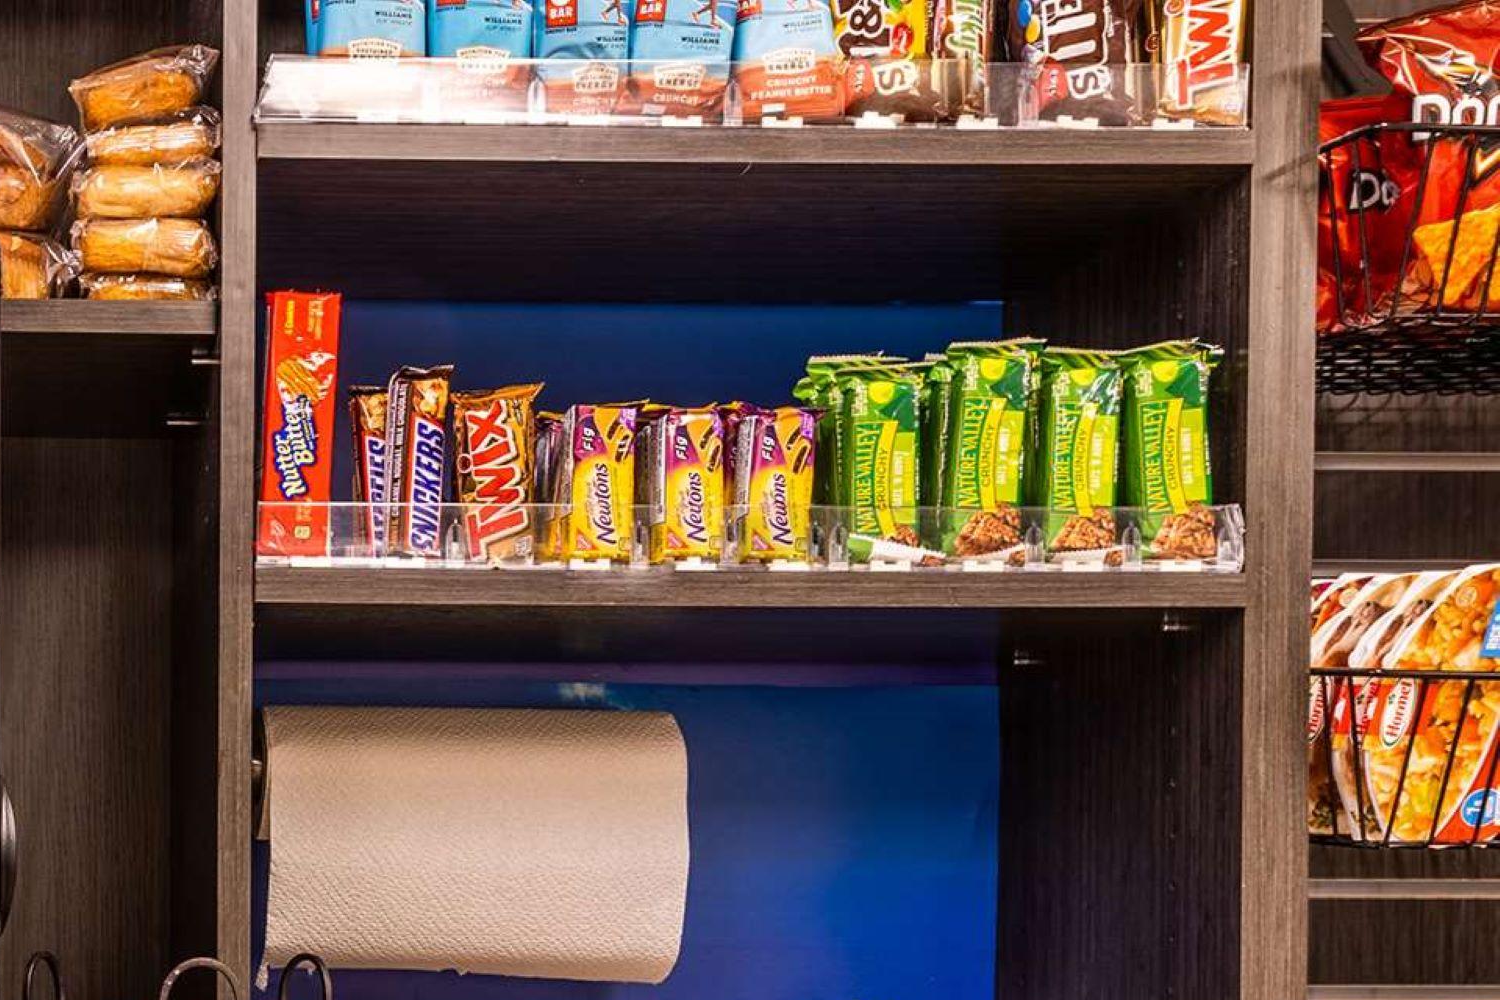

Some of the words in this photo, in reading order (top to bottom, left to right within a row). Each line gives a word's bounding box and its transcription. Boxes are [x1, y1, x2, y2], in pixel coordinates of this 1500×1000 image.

[550, 7, 573, 19] BAR
[640, 4, 663, 15] BAR
[288, 400, 315, 465] Butter
[583, 426, 596, 452] Fig
[675, 435, 688, 460] Fig
[762, 435, 775, 462] Fig
[856, 423, 882, 475] VALLEY
[962, 400, 988, 450] VALLEY
[1055, 408, 1079, 457] VALLEY
[1143, 408, 1166, 456] VALLEY
[275, 432, 307, 498] Nutter
[410, 420, 444, 552] SNICKERS
[466, 400, 529, 561] TWIX
[959, 451, 982, 508] NATURE
[1054, 458, 1077, 513] NATURE
[1144, 458, 1173, 513] NATURE
[592, 462, 617, 545] Newtons
[683, 471, 708, 544] Newtons
[773, 473, 794, 545] Newtons
[855, 476, 880, 534] NATURE
